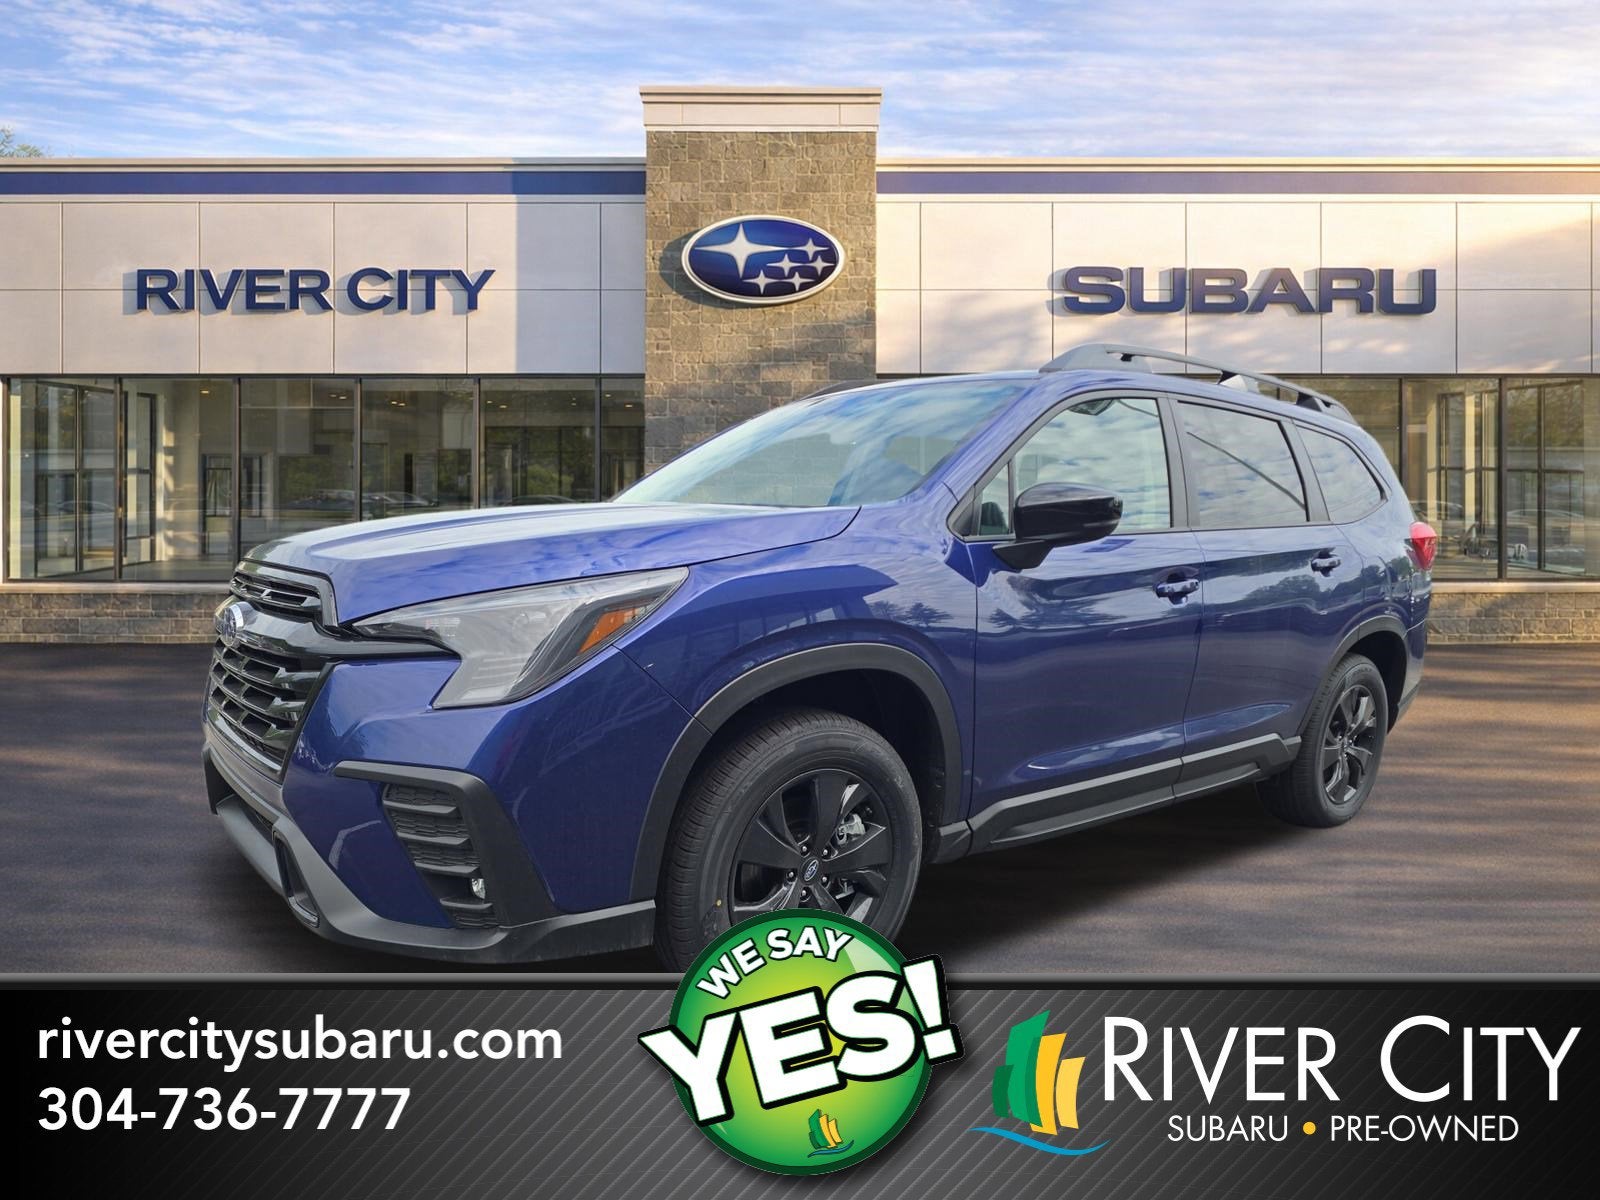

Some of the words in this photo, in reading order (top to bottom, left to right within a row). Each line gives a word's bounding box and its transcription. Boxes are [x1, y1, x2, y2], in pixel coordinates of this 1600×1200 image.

[136, 268, 334, 311] RIVER
[347, 266, 496, 311] CITY
[1063, 266, 1437, 315] SUBARU
